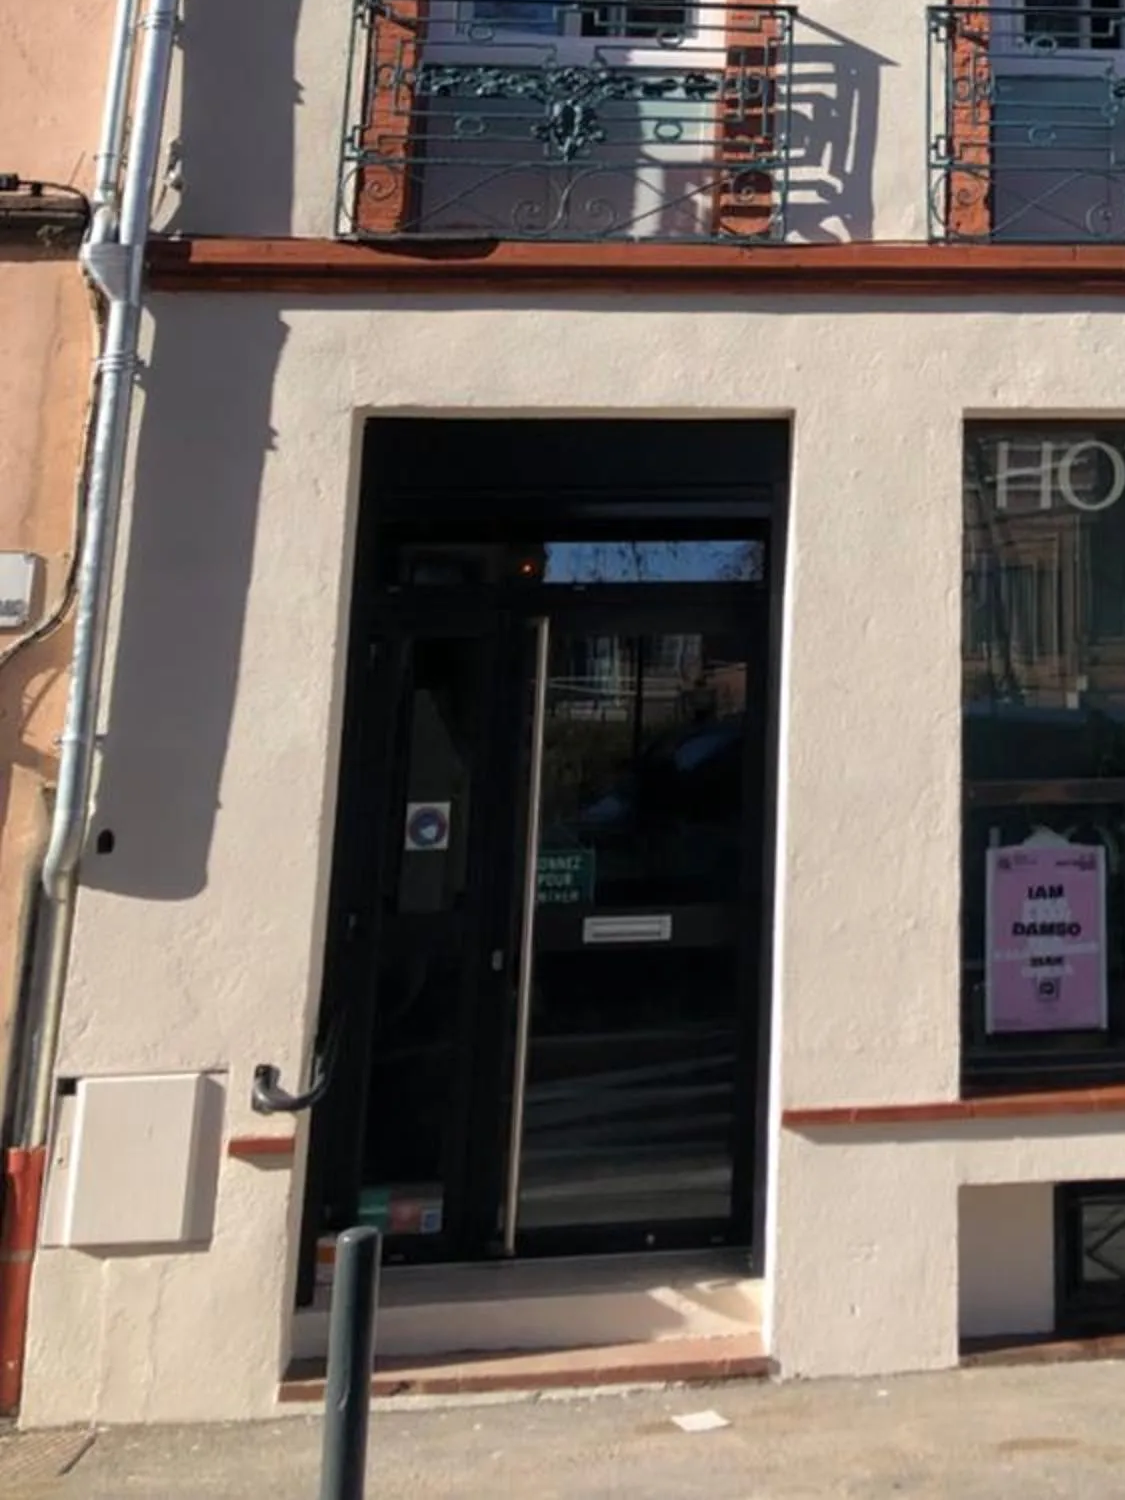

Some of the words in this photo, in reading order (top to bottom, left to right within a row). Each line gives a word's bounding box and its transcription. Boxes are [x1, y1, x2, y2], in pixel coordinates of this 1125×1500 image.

[537, 856, 582, 871] ONNEZ
[1027, 884, 1065, 900] IAM
[1012, 921, 1083, 937] DAMSO
